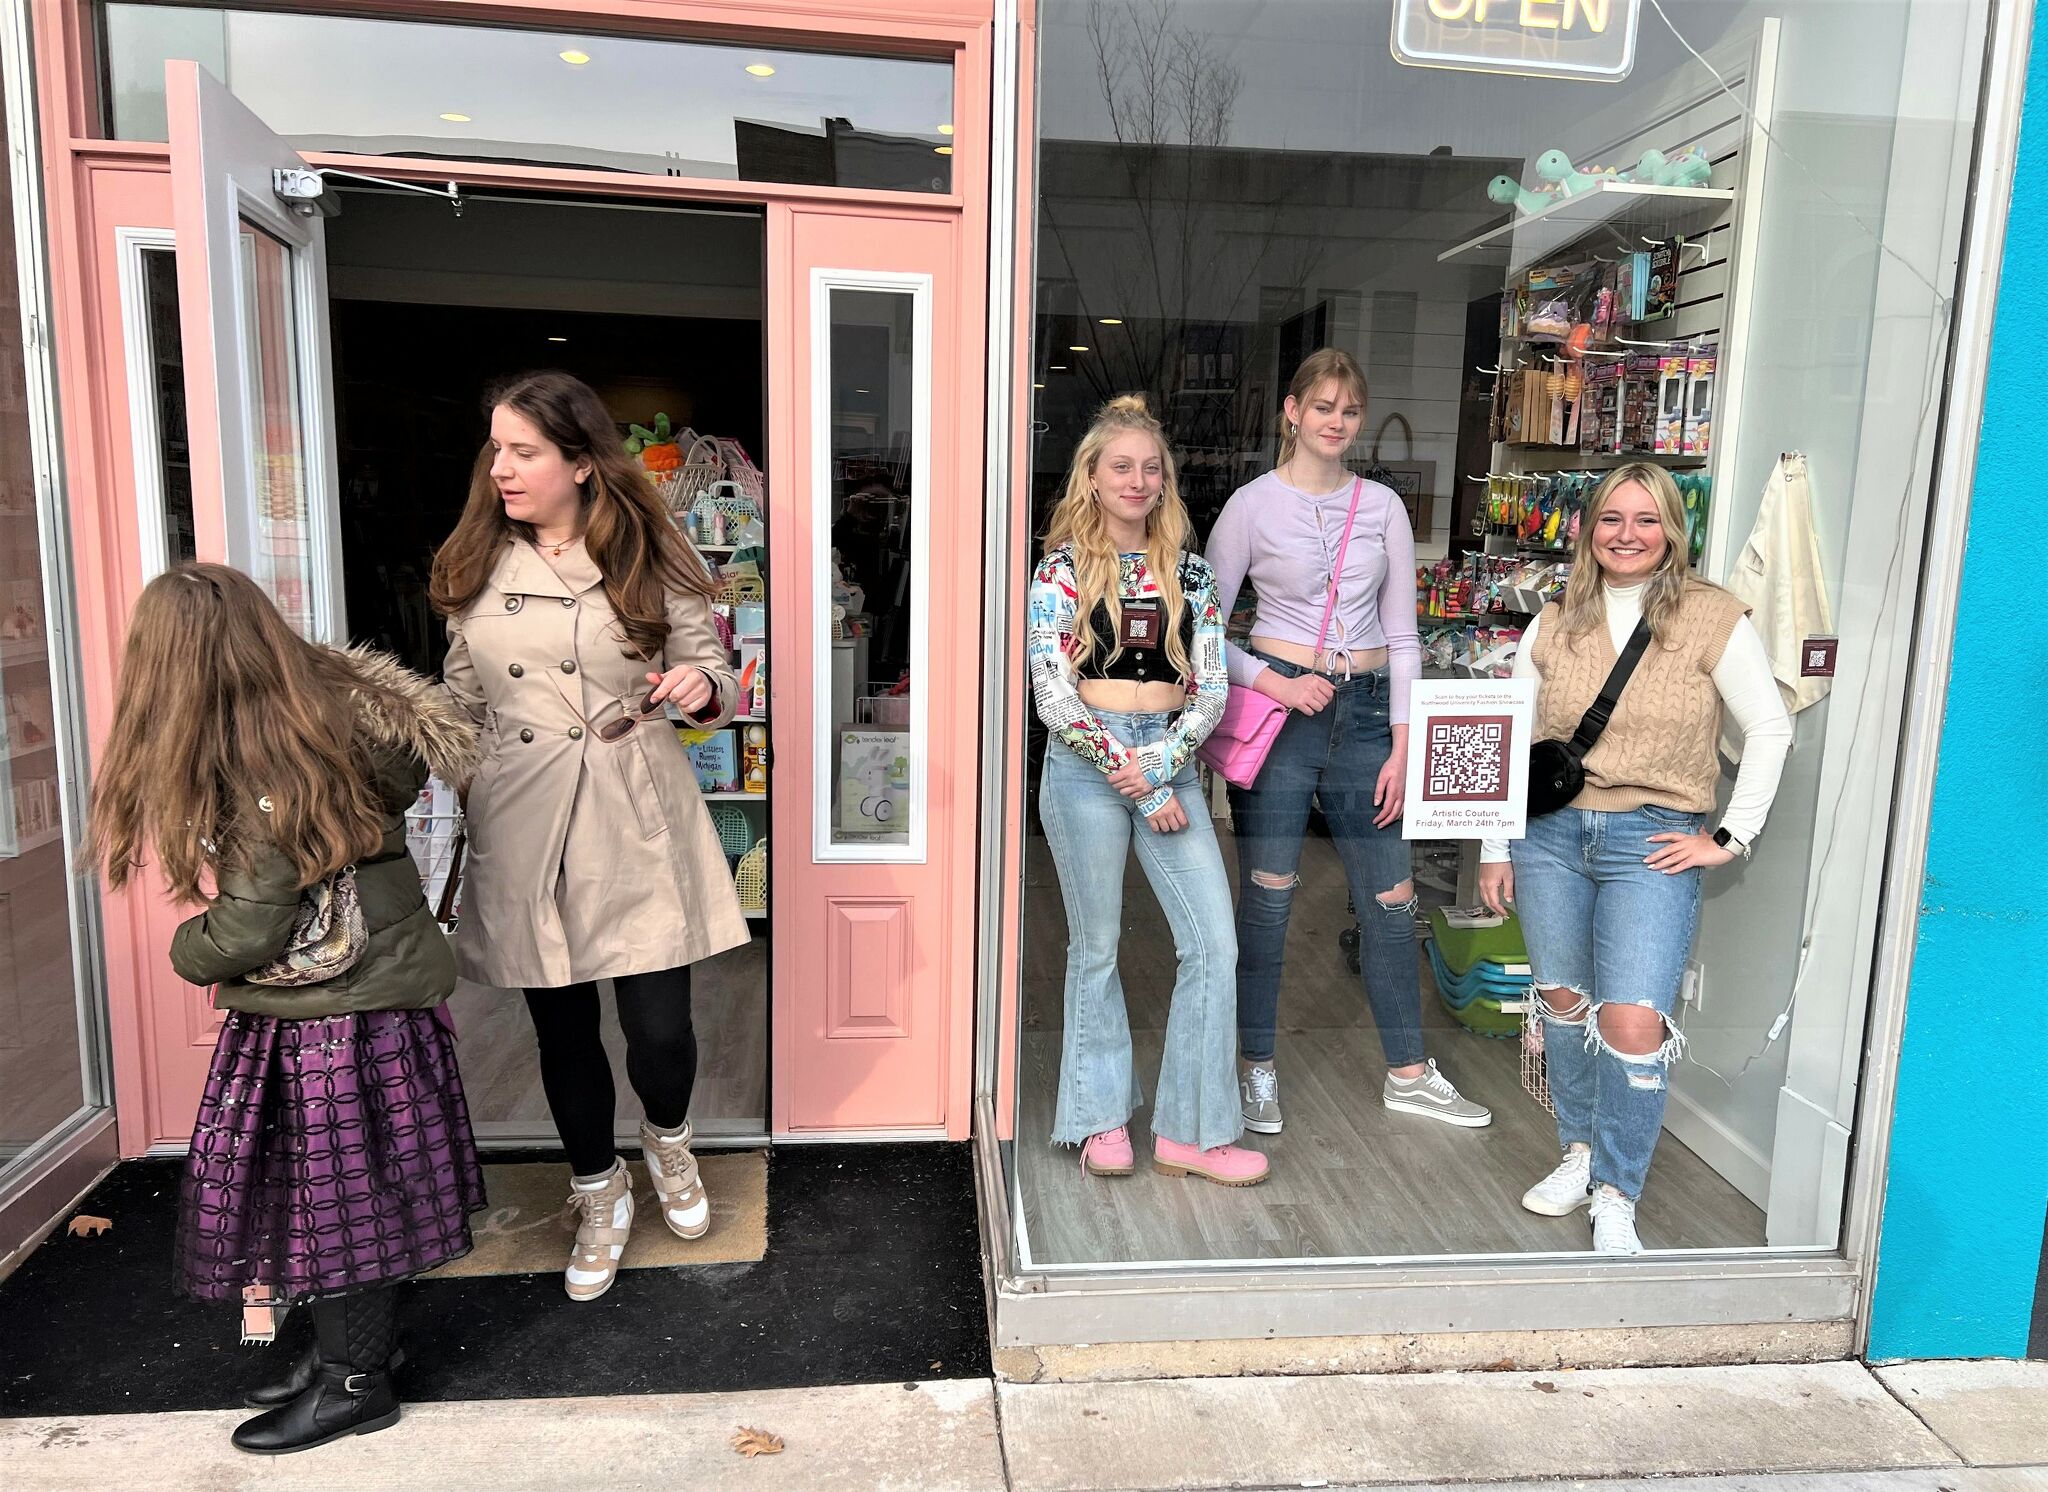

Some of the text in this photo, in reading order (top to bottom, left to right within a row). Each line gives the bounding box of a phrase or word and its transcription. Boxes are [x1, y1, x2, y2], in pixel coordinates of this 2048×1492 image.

[695, 760, 722, 772] Michigan
[1431, 809, 1500, 817] Artistic Couture
[1446, 819, 1473, 827] March
[1475, 819, 1494, 827] 24th
[1496, 819, 1515, 828] 7pm
